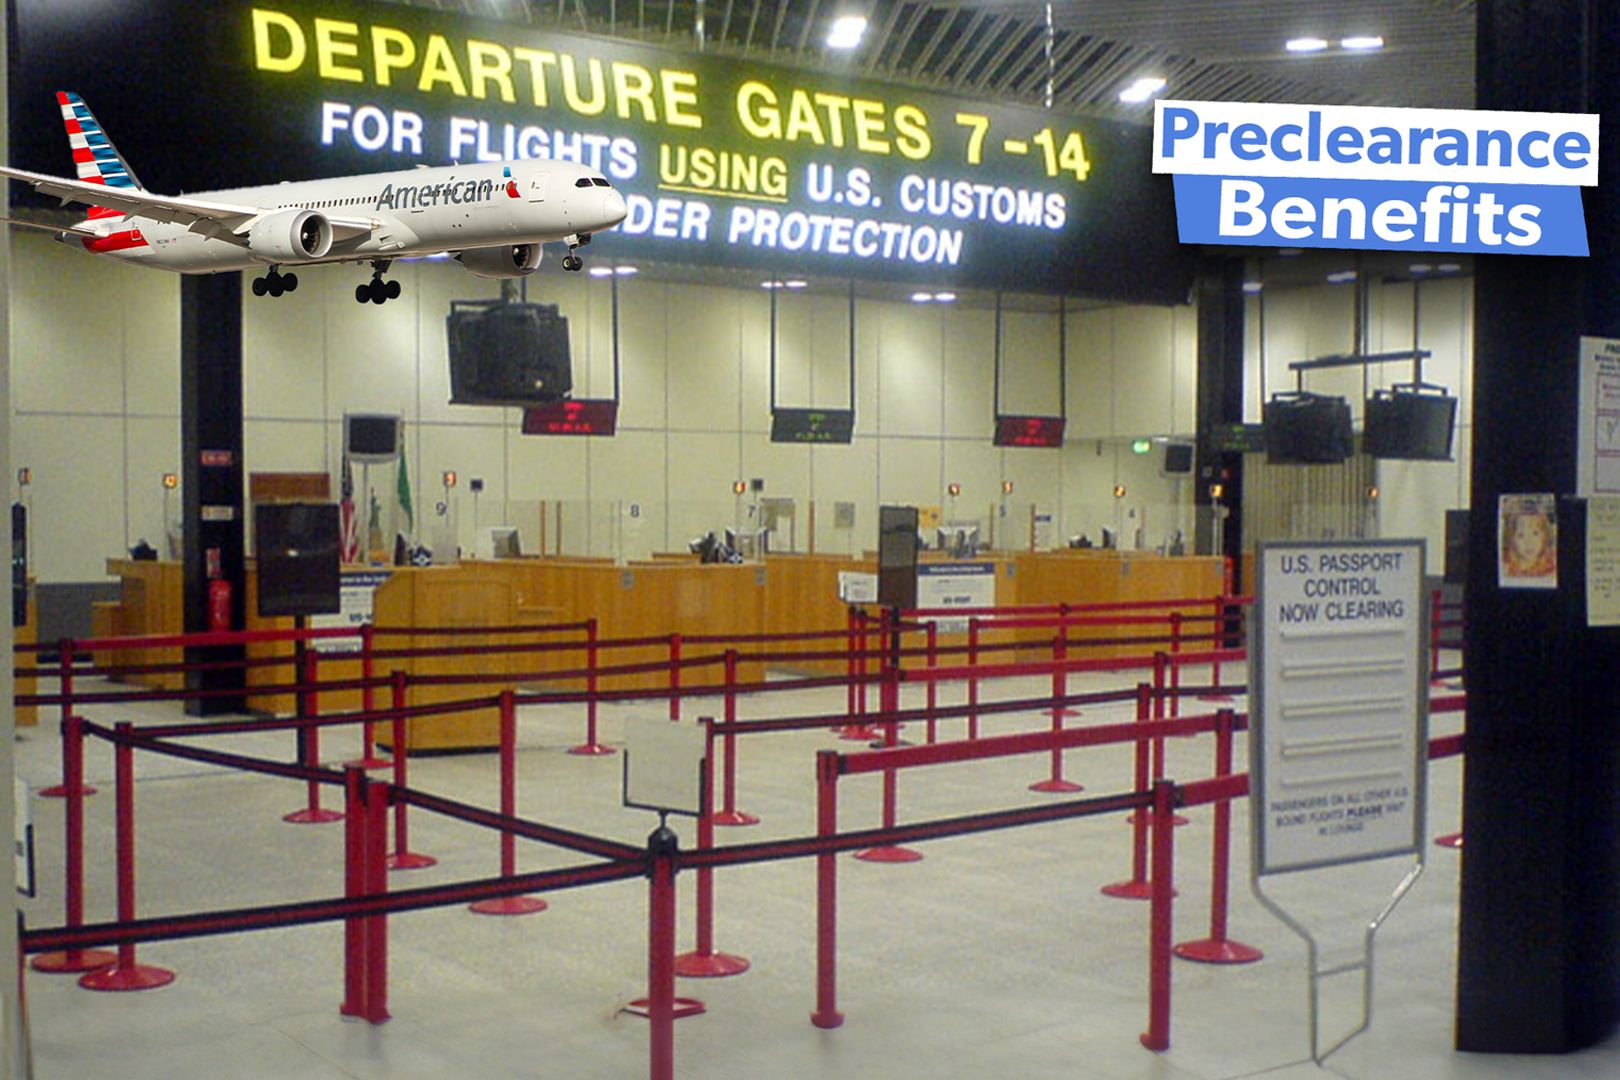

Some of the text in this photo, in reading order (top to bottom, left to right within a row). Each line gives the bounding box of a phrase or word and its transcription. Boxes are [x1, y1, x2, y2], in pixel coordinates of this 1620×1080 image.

[252, 8, 702, 130] DEPARTURE
[736, 79, 932, 160] GATES
[321, 101, 1067, 230] FOR FLIGHTS USING U.S. CUSTOMS
[375, 176, 494, 211] American
[728, 206, 963, 265] PROTECTION
[630, 504, 640, 518] 8
[1281, 552, 1403, 574] U.S. PASSPORT
[1303, 577, 1381, 597] CONTROL
[1279, 600, 1404, 623] NOW CLEARING
[1346, 804, 1382, 817] PLEASE
